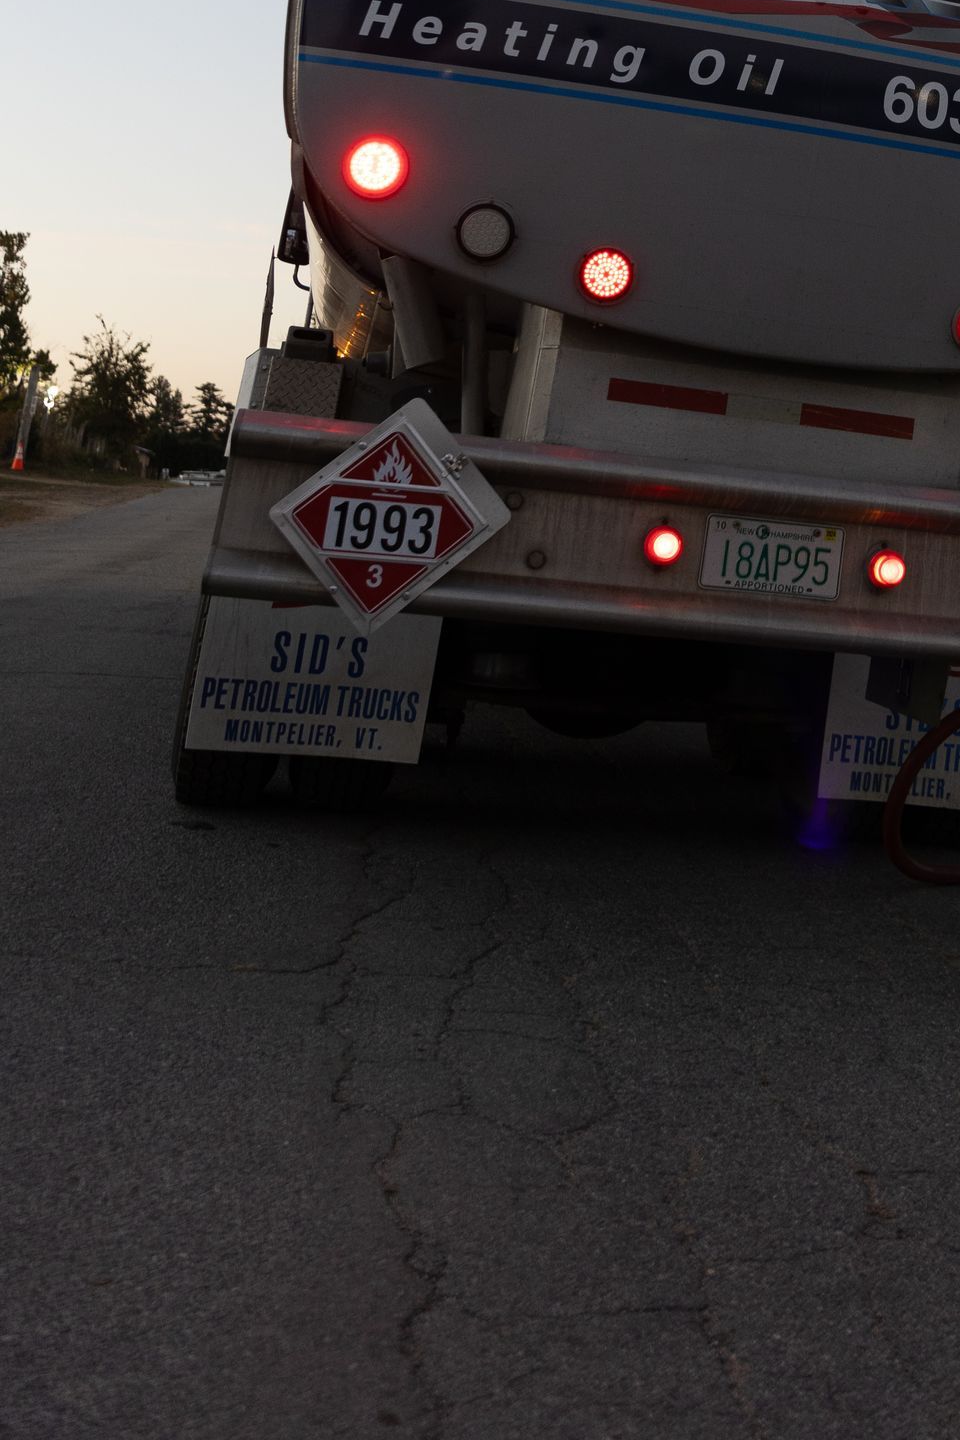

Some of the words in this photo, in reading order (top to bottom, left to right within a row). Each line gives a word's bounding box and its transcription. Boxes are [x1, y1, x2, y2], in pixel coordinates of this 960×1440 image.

[687, 48, 785, 96] Oil
[333, 500, 436, 555] 1993
[716, 520, 727, 530] 10
[736, 527, 755, 536] NEW
[769, 531, 816, 543] HAMPSHIRE
[365, 563, 384, 589] 3
[734, 580, 805, 595] APPORTIONED
[270, 630, 369, 678] SID'S
[200, 677, 331, 716] PETROLEUM
[336, 685, 420, 724] TRUCKS
[224, 718, 342, 747] MONTPELIER,
[354, 727, 383, 751] VT.
[850, 770, 951, 800] MONTLIER,
